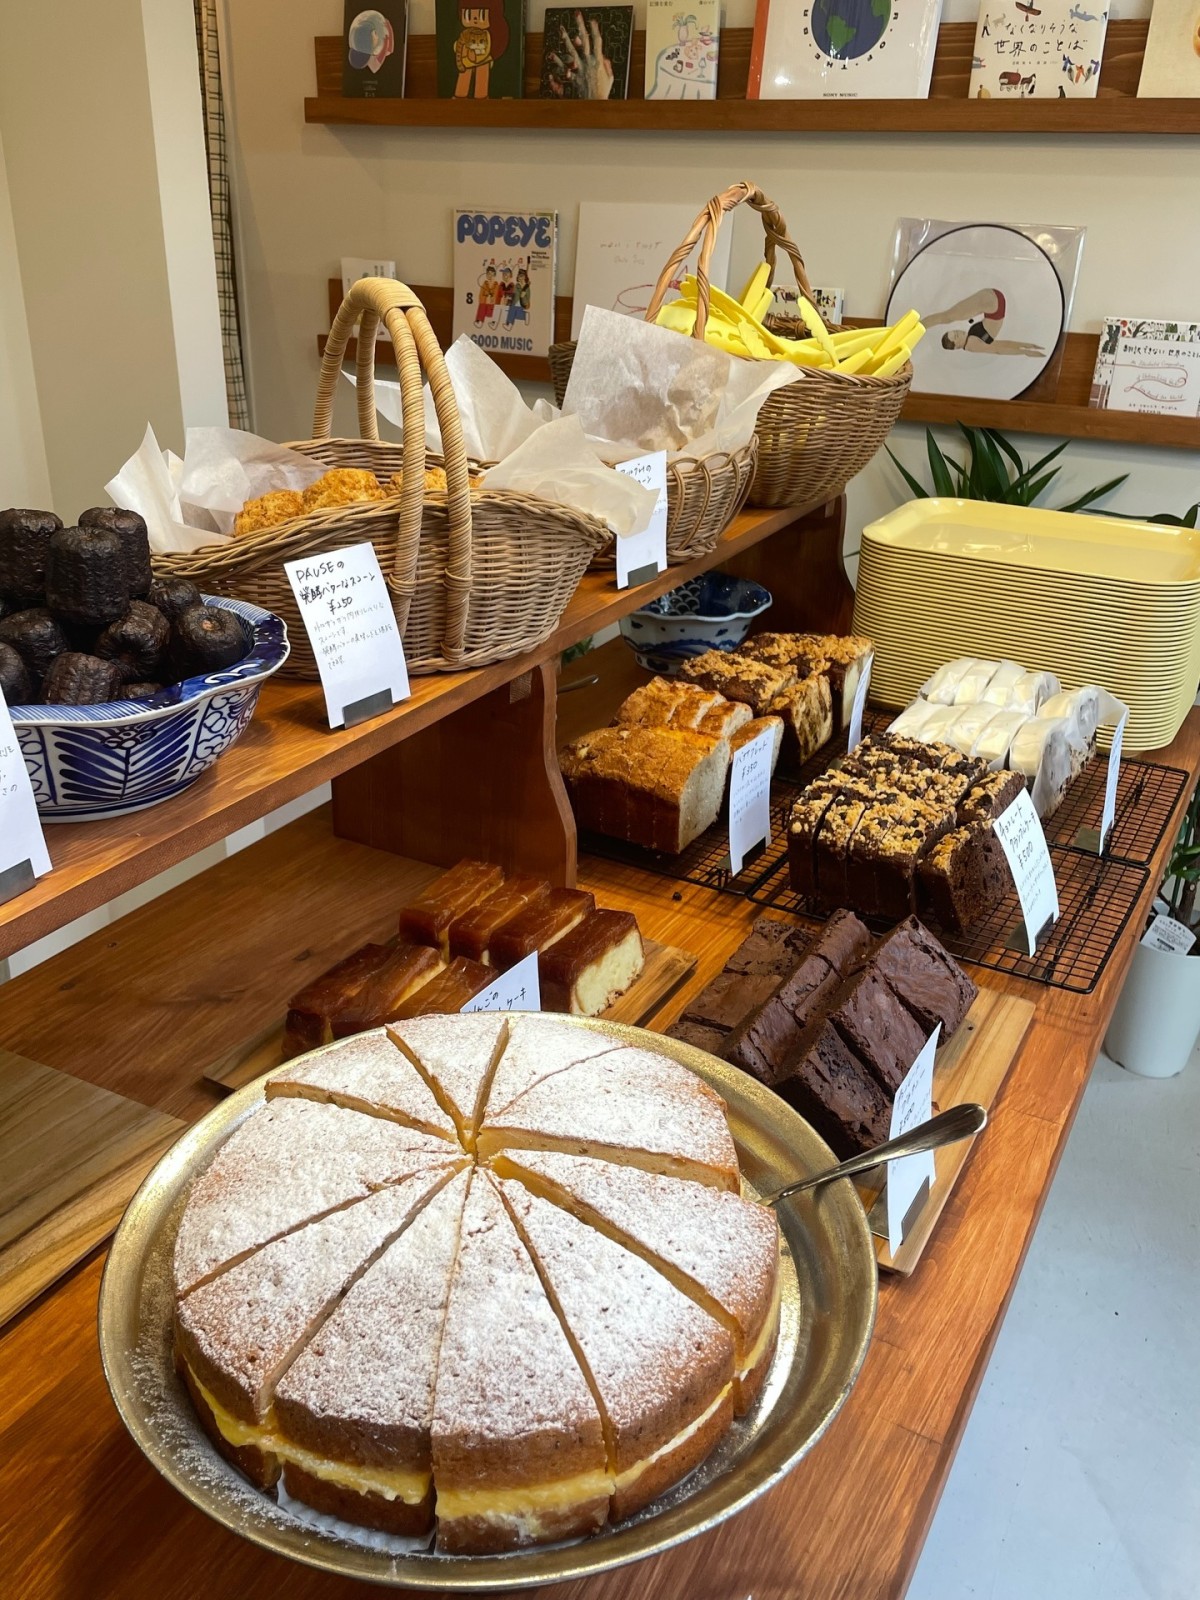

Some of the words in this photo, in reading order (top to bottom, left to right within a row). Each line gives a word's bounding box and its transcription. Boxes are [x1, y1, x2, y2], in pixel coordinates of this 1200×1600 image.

[1005, 20, 1077, 35] なくなりそうな
[994, 39, 1088, 57] 世界のことば
[457, 213, 552, 249] POPEYE
[466, 292, 474, 305] 8
[470, 334, 500, 349] GOOD
[500, 336, 533, 352] MUSIC
